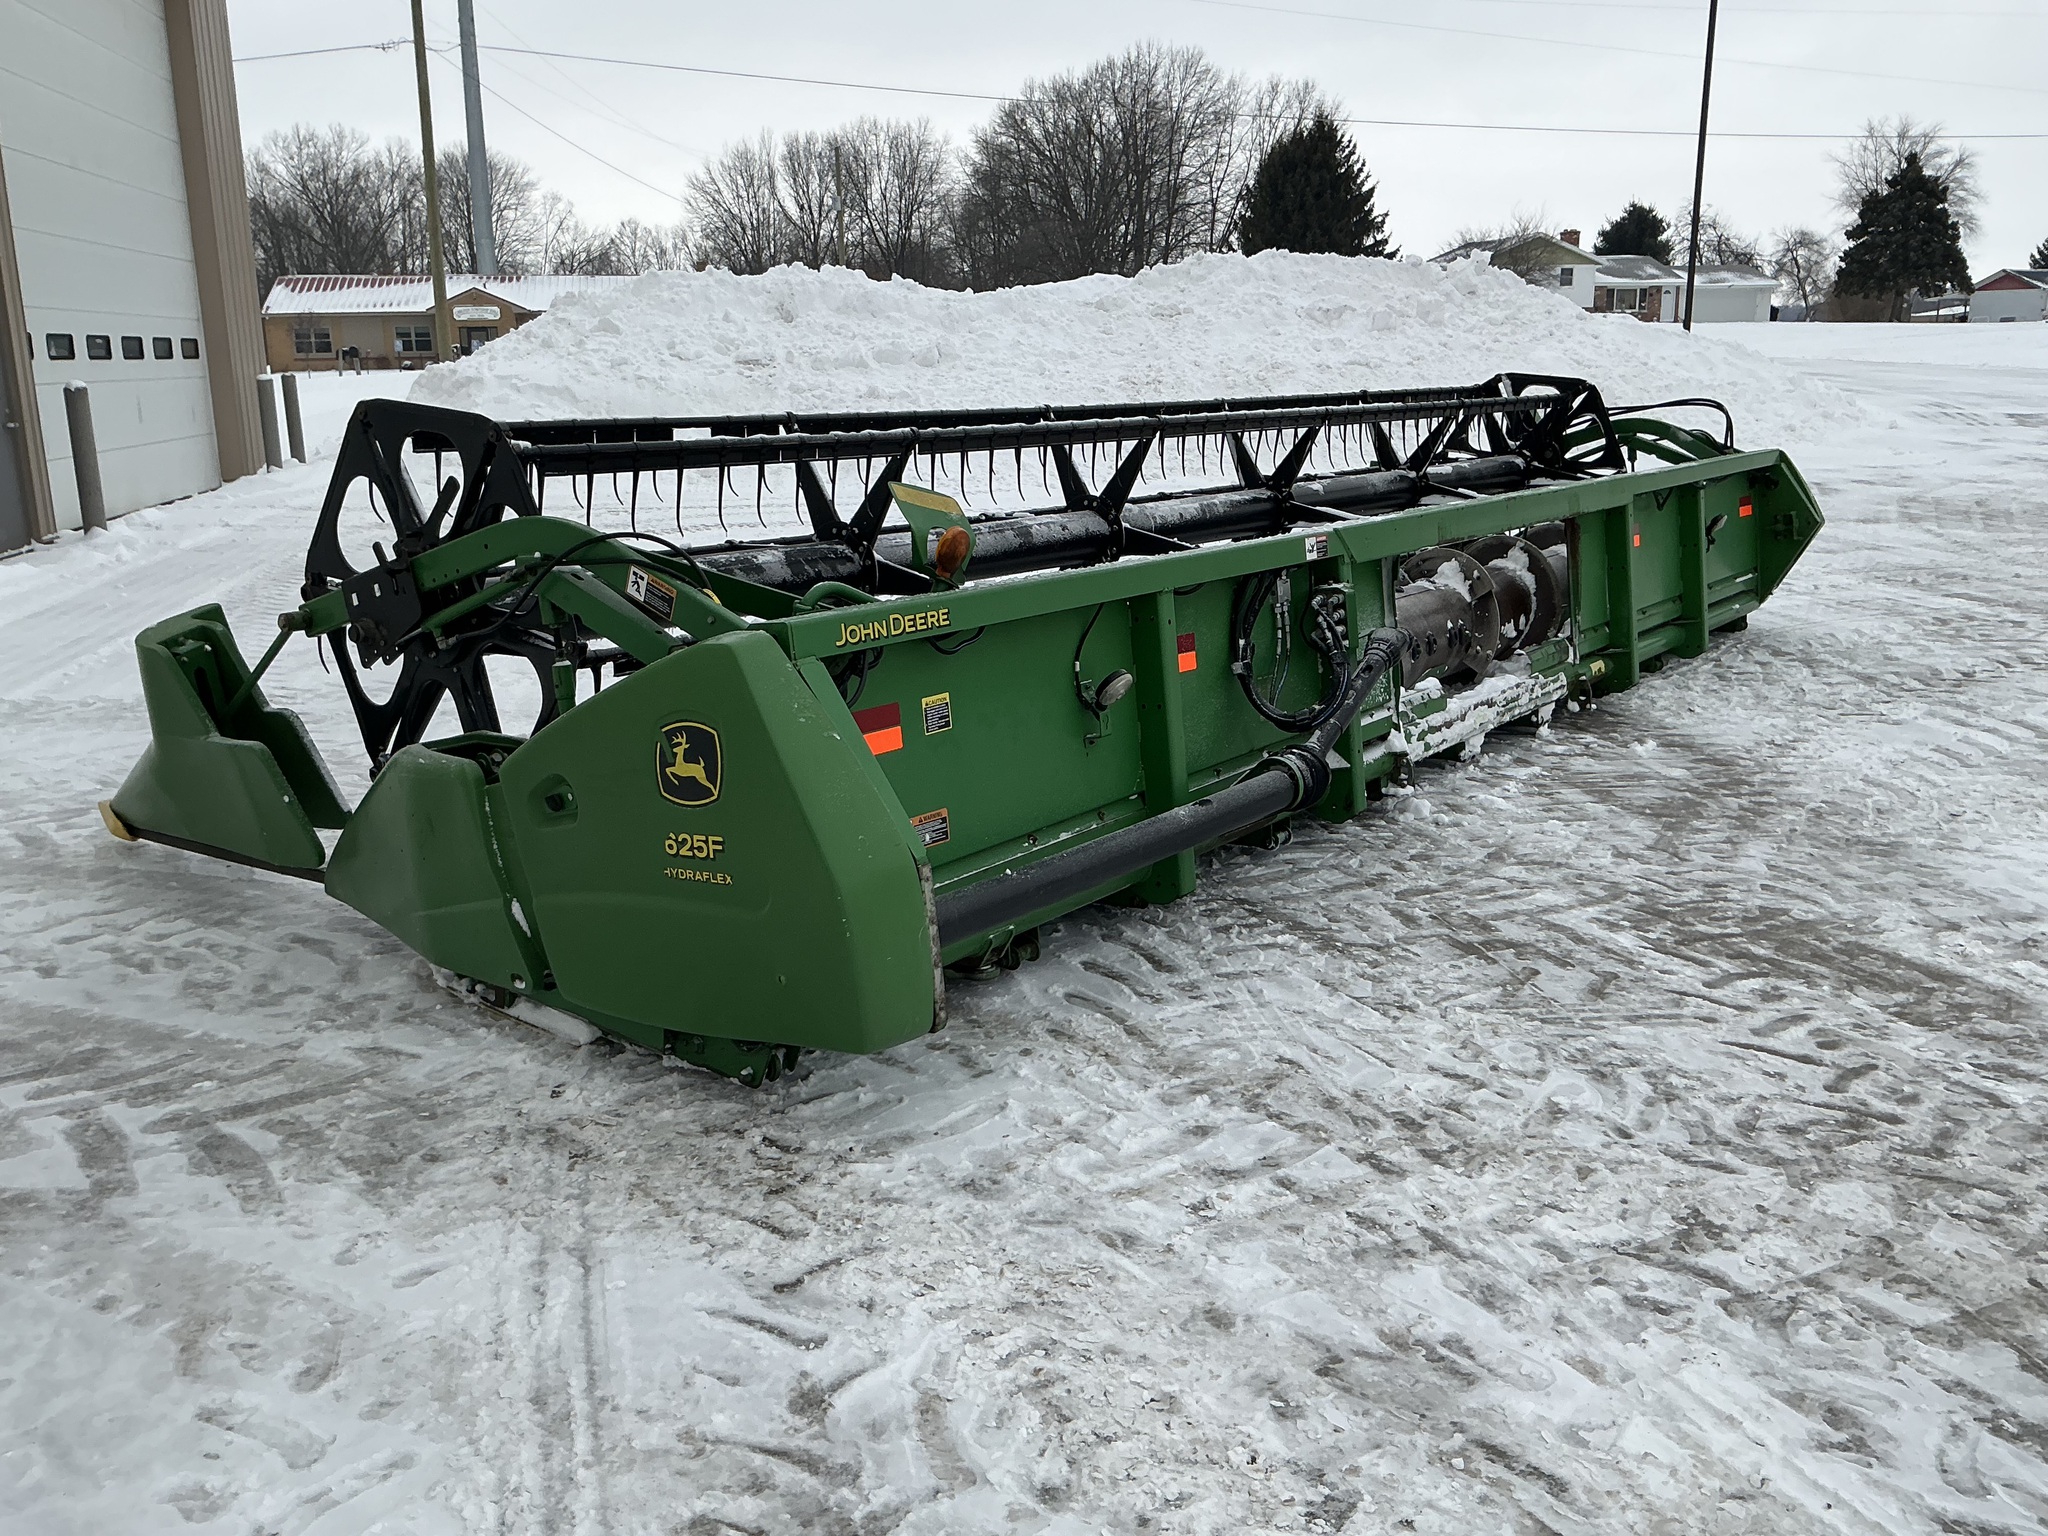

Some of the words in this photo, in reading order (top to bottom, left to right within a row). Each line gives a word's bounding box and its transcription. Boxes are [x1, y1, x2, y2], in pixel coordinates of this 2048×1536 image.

[835, 619, 888, 647] JOHN
[889, 608, 950, 636] DEERE
[928, 697, 947, 706] CAUTION
[923, 811, 943, 821] WARNING
[665, 832, 724, 859] 625F
